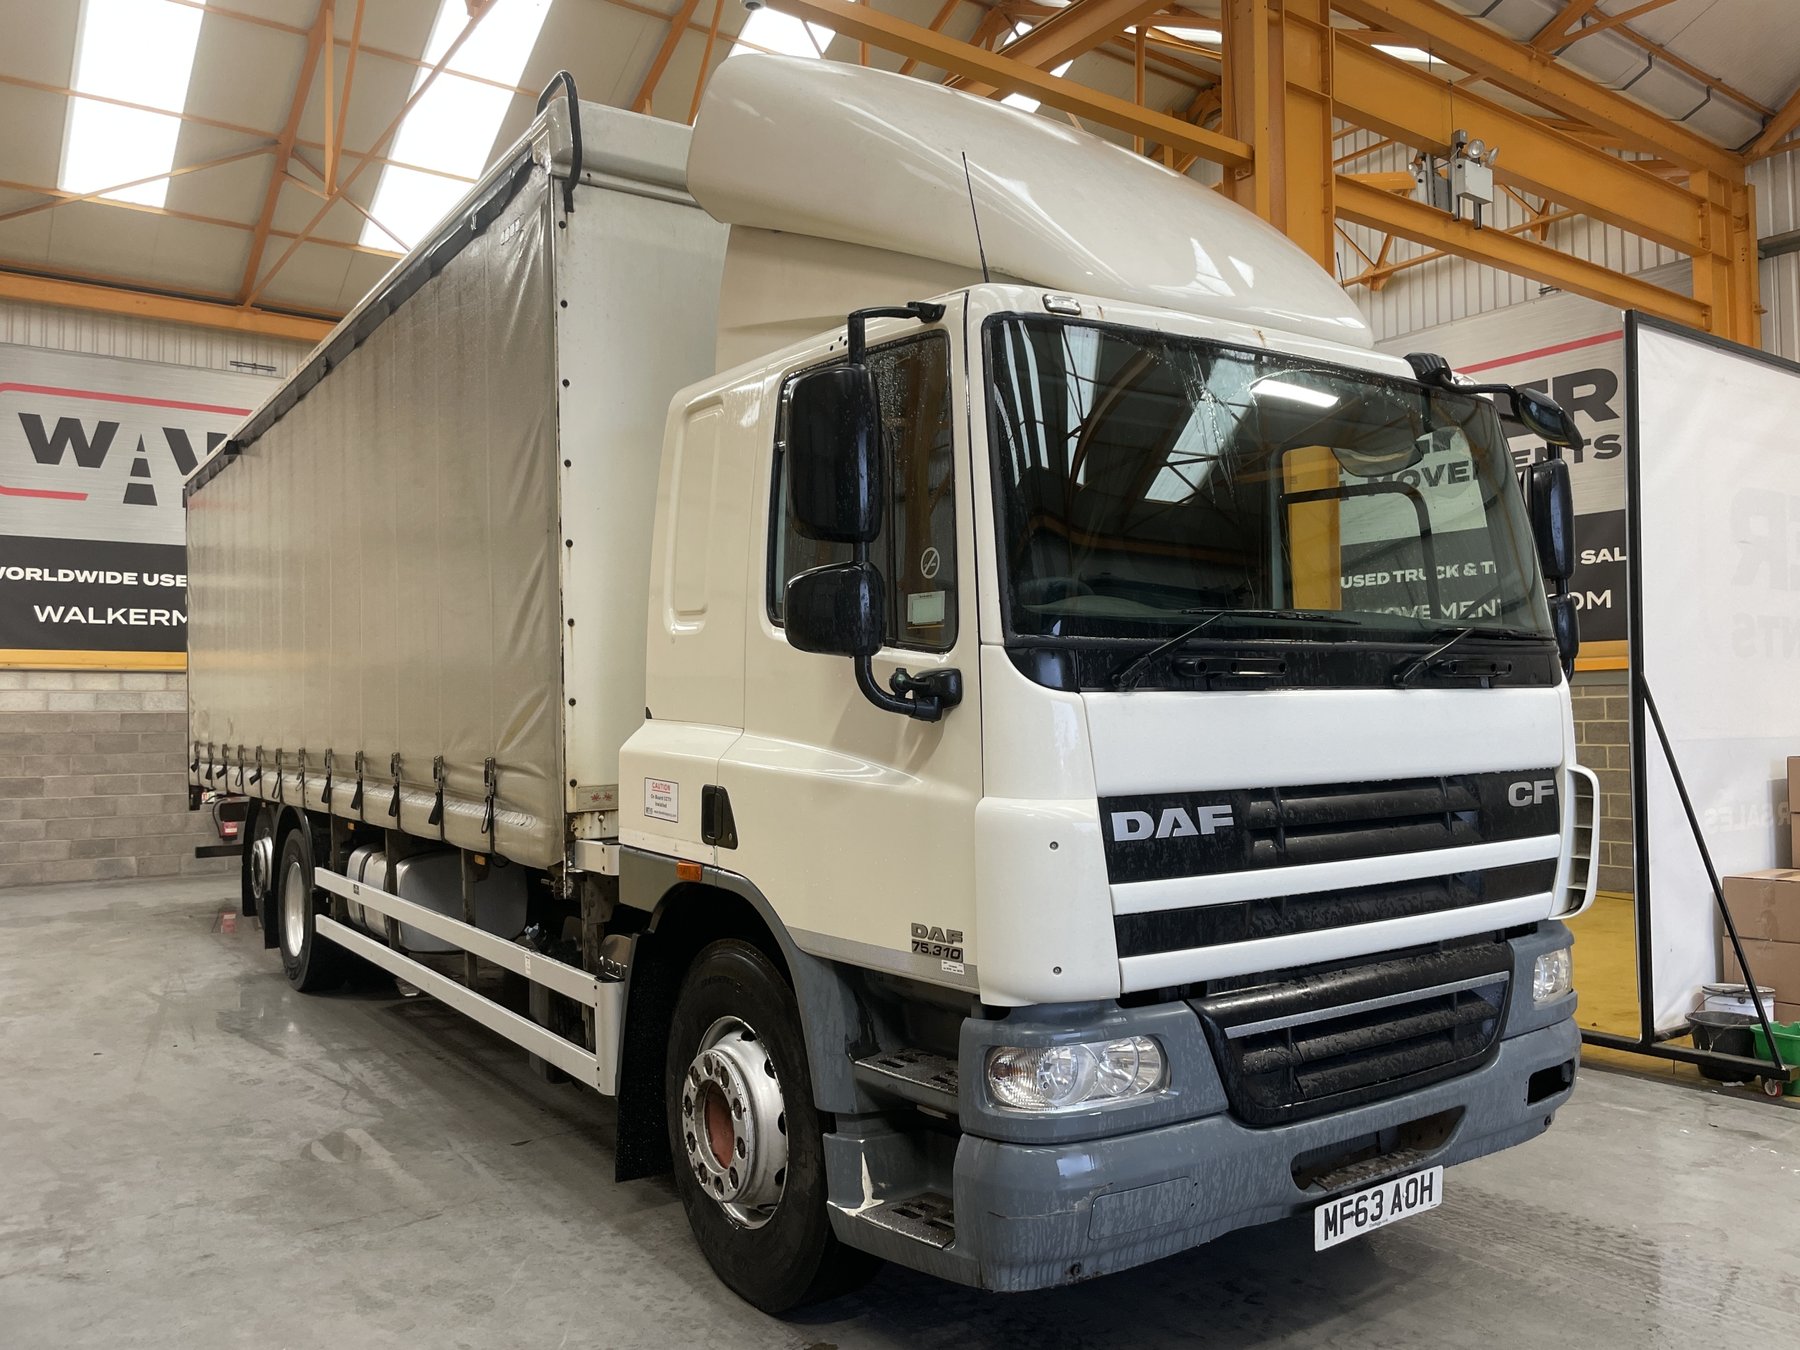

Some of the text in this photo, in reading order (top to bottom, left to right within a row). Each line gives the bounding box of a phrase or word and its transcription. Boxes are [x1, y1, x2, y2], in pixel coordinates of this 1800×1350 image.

[0, 566, 138, 585] ORLDWIDE
[1341, 573, 1390, 589] USED
[1463, 563, 1477, 577] &
[1508, 779, 1554, 807] CF
[1111, 804, 1234, 842] DAF
[911, 922, 963, 945] DAF
[912, 940, 961, 960] 75.310
[1324, 1172, 1434, 1240] MF63 AOH
